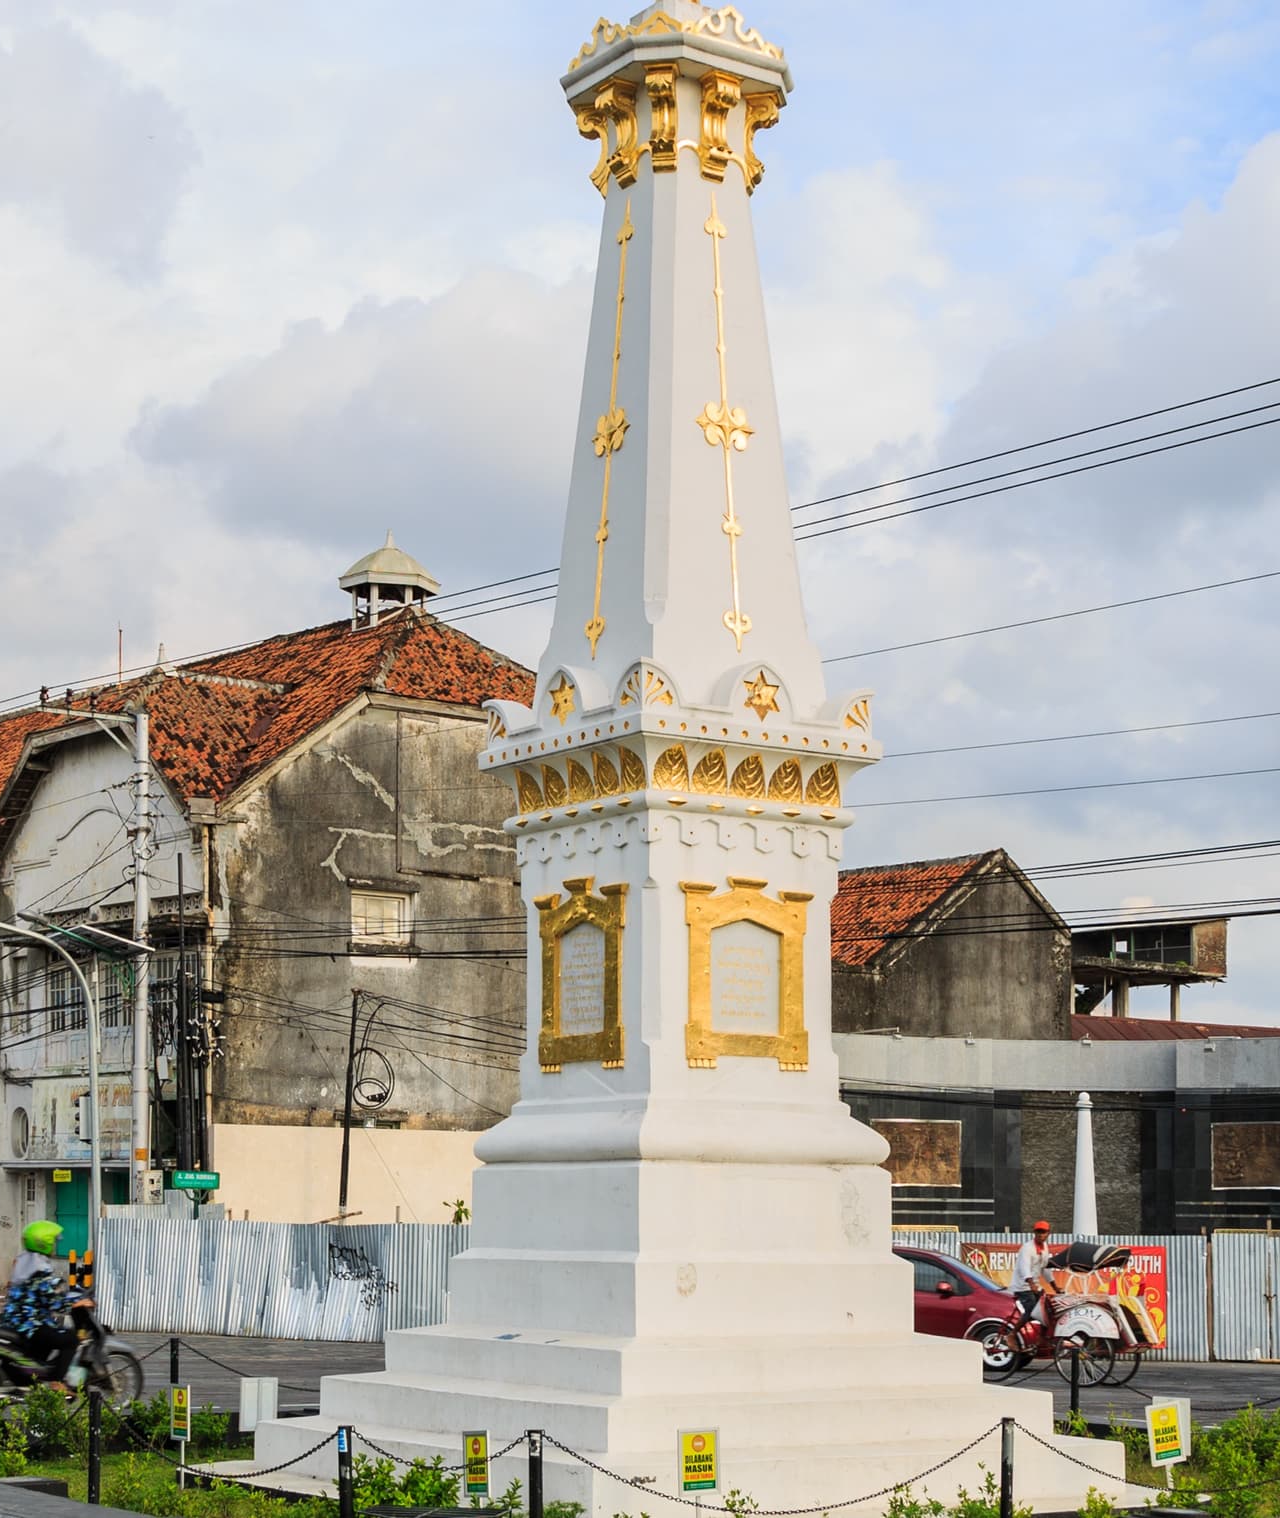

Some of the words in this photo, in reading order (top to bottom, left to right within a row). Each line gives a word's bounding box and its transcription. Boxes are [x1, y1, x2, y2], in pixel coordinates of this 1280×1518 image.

[1127, 1255, 1162, 1274] PUTIH
[1155, 1435, 1178, 1444] MASUK
[685, 1454, 712, 1464] DILARANG
[685, 1464, 712, 1472] MASUK
